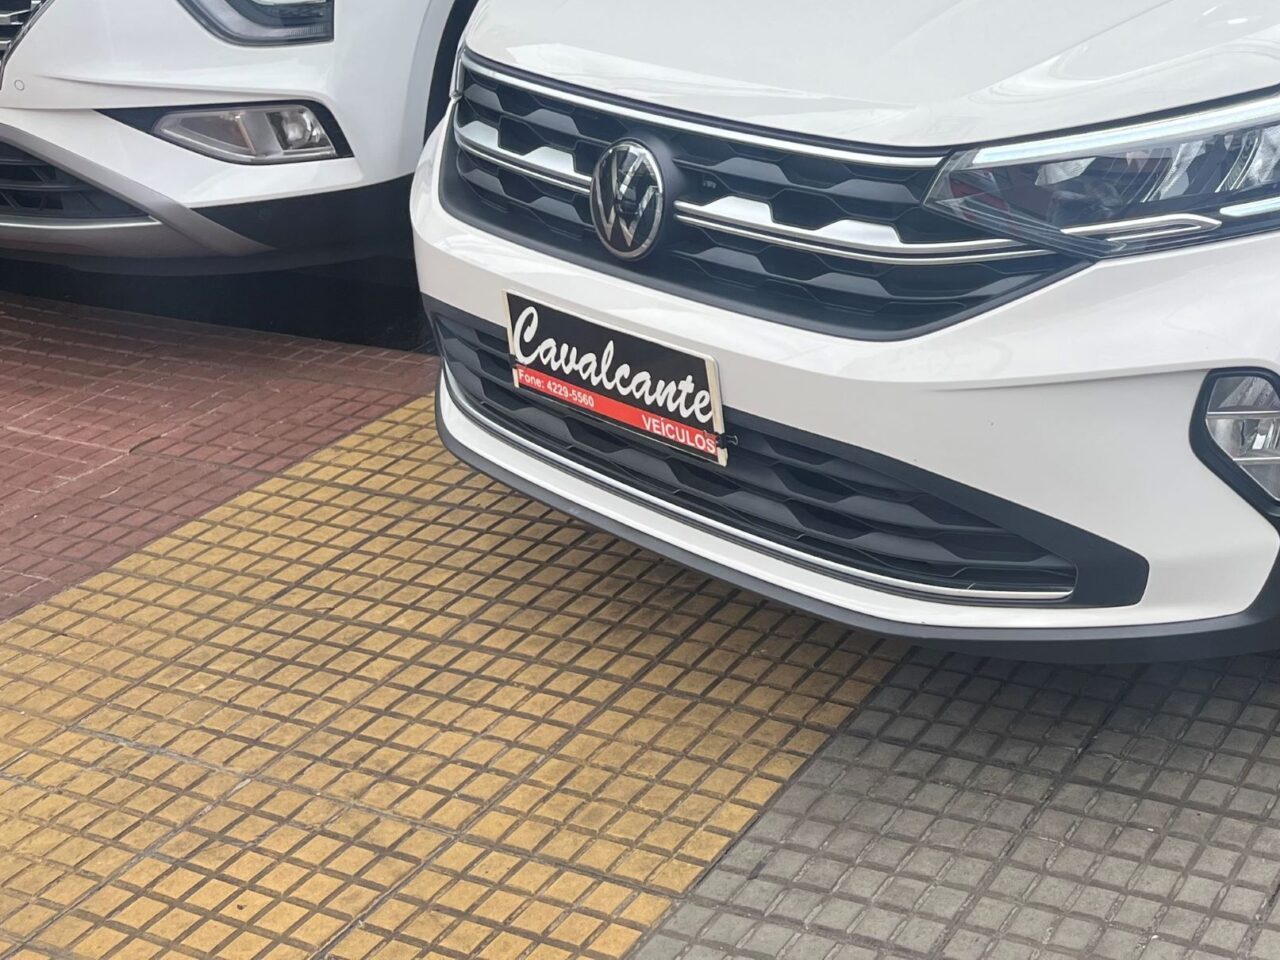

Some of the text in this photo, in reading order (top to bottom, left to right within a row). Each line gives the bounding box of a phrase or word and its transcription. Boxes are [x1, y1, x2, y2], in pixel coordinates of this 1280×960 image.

[513, 306, 714, 424] Cavalcante
[519, 368, 595, 408] Fone: 4229-5560
[641, 415, 717, 454] VEÍCULOS
